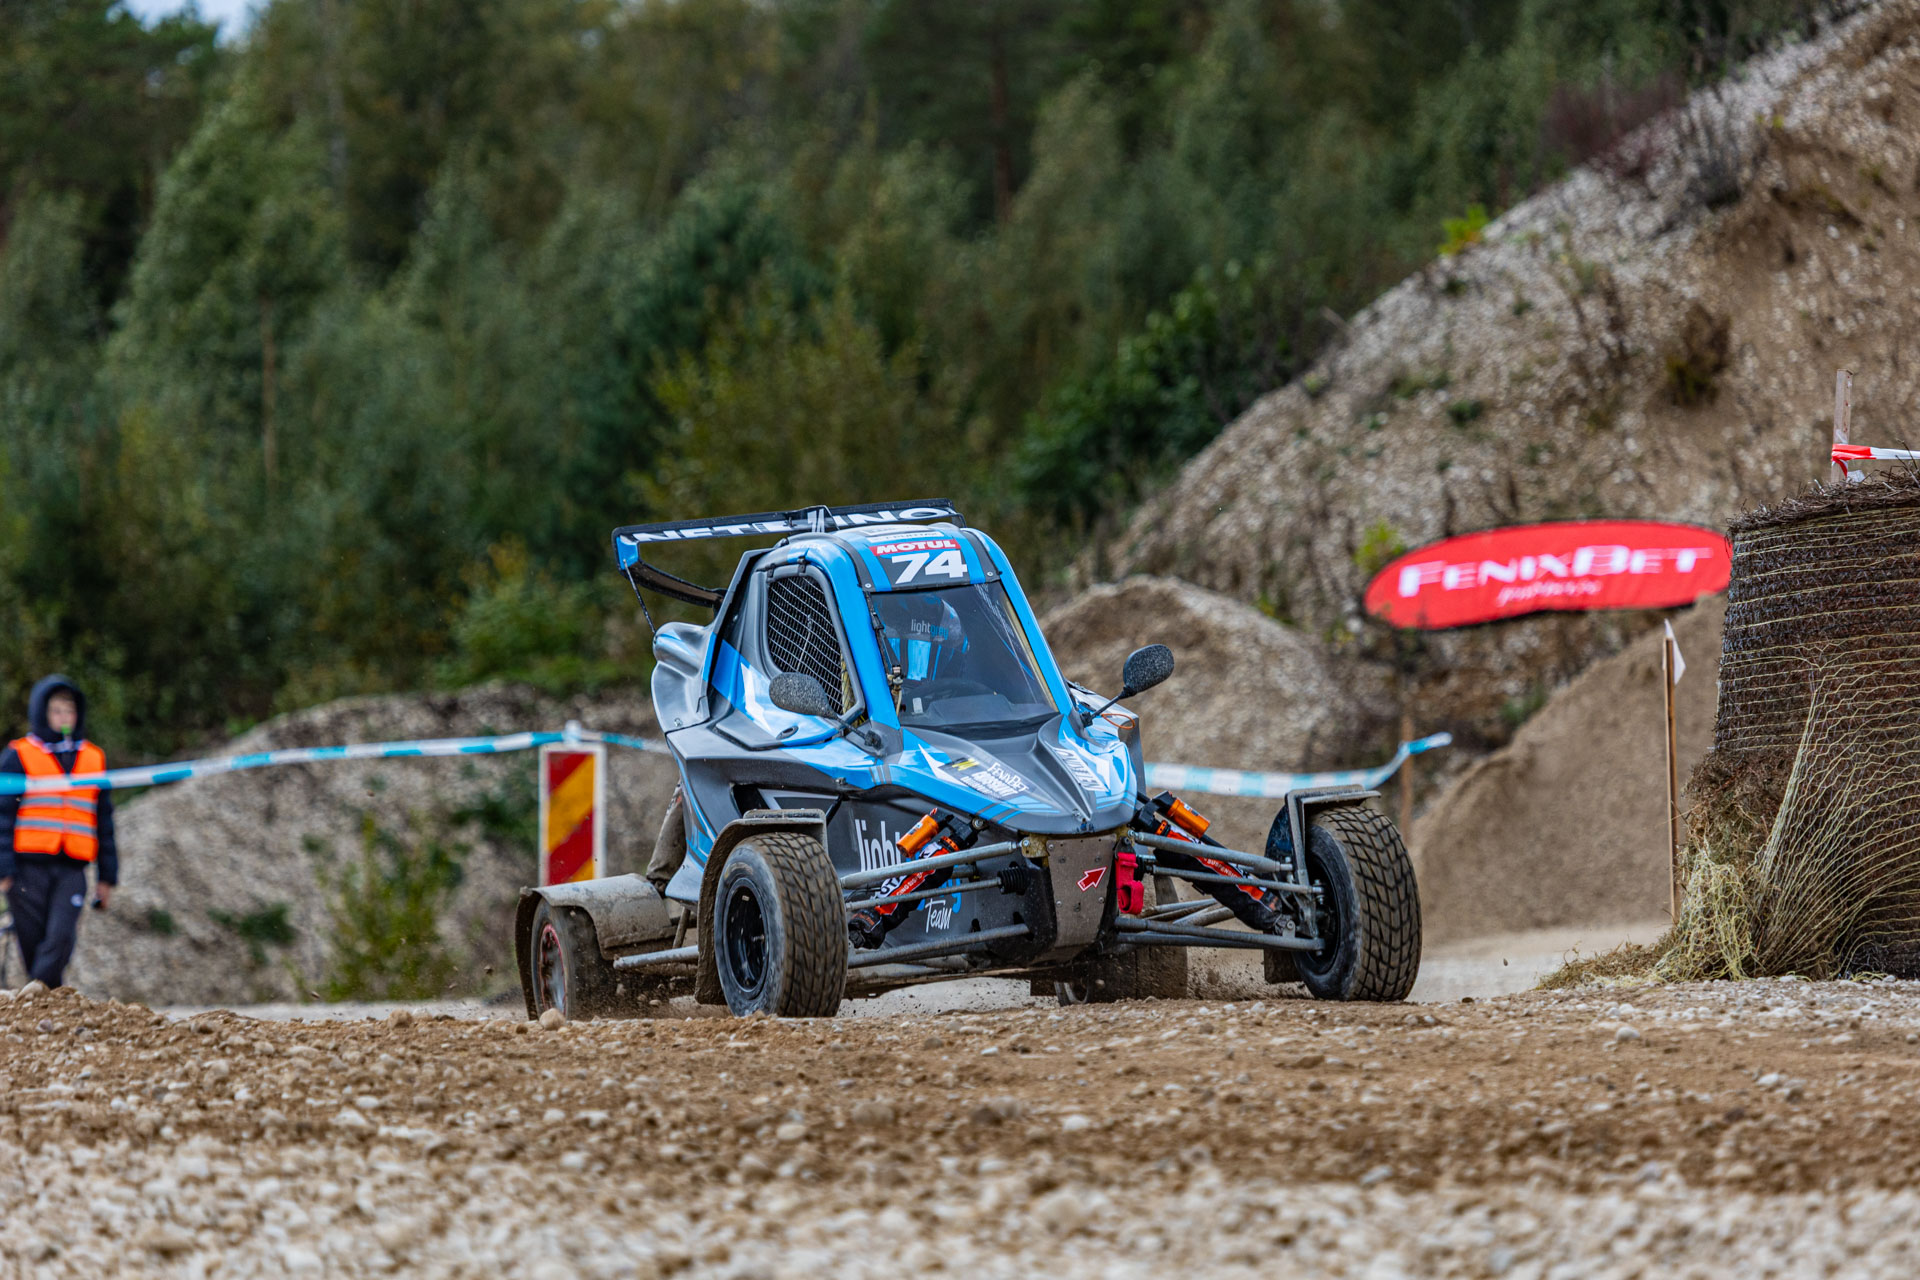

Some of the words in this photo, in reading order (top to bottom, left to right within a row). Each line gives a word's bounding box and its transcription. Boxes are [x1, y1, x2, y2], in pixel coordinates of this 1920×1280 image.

[876, 539, 956, 555] MOTUL
[892, 551, 968, 585] 74
[925, 898, 952, 933] Team
